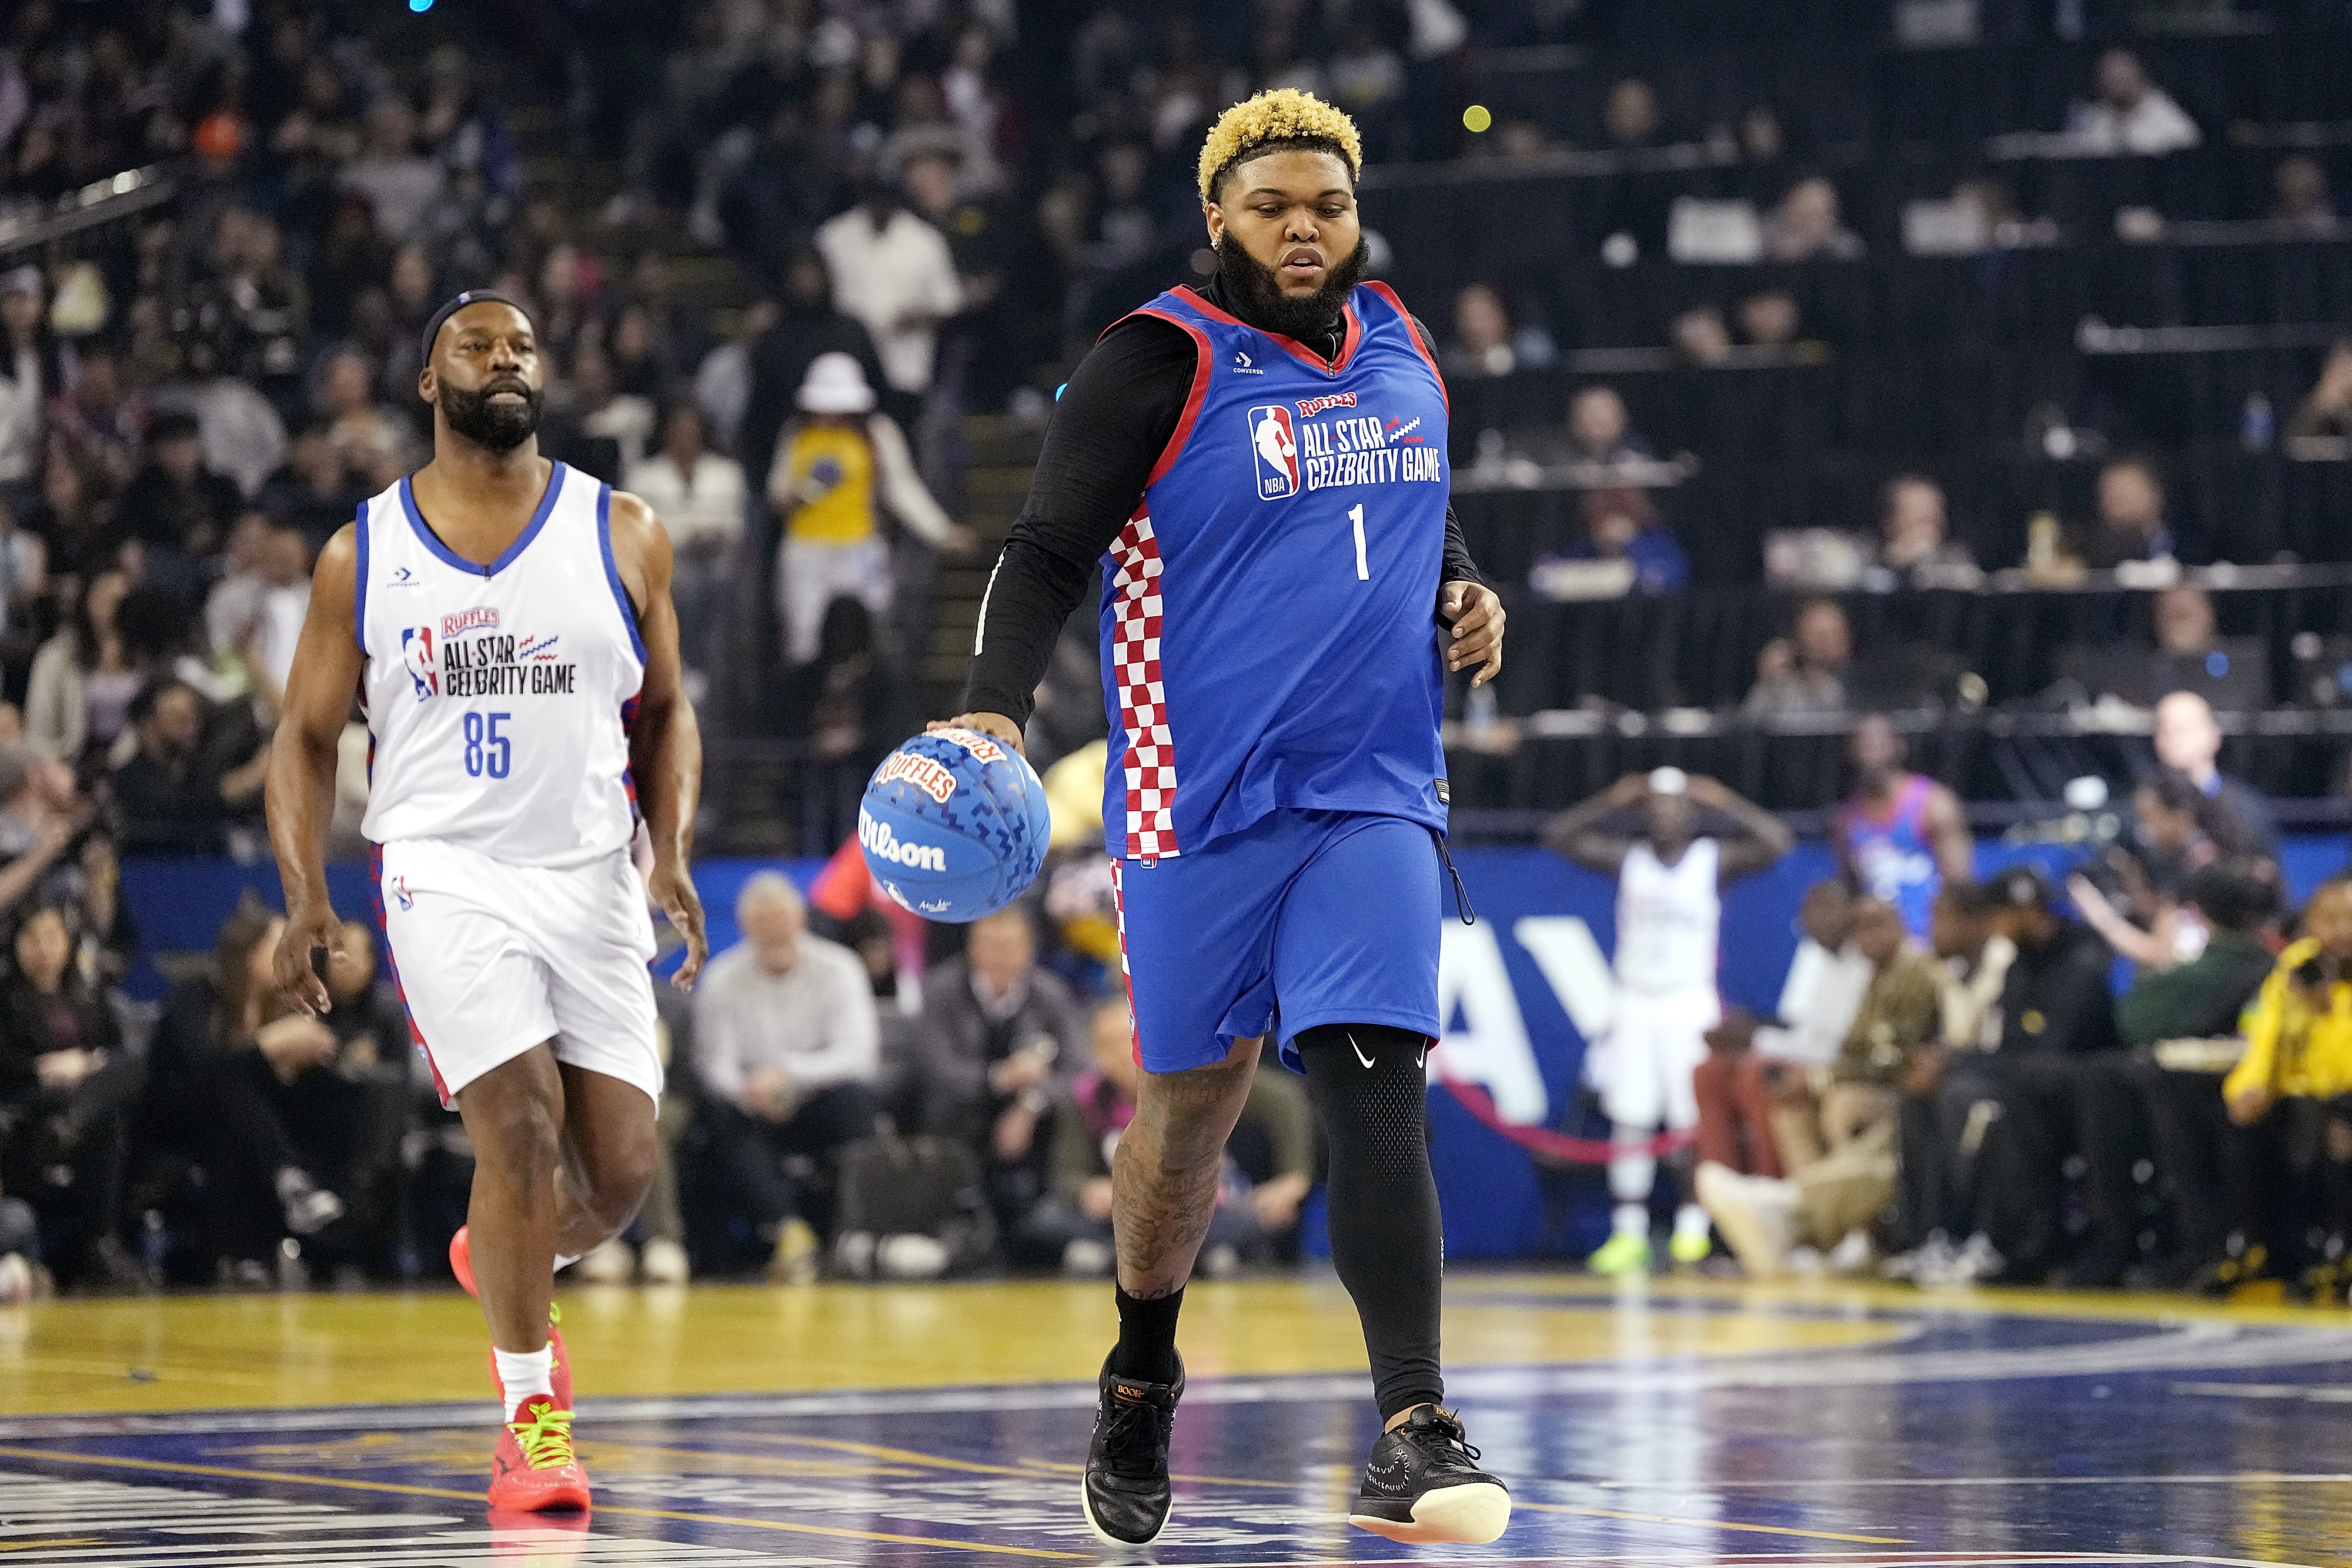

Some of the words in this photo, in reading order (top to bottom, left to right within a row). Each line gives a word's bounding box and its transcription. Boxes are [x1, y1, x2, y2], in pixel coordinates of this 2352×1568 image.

[1296, 392, 1357, 417] RUFFLES
[1302, 422, 1335, 457] ALL
[1335, 417, 1386, 452] STAR
[1265, 476, 1285, 494] NBA
[1306, 448, 1399, 492] CELEBRITY
[1402, 447, 1441, 482] GAME
[1348, 504, 1369, 580] 1
[443, 608, 499, 635] RUFFLES
[445, 641, 473, 671] ALL
[476, 635, 514, 666] STAR
[446, 666, 527, 696] CELEBRITY
[531, 664, 576, 694] GAME
[463, 712, 511, 779] 85
[877, 753, 955, 801] RUFFLES
[1118, 1385, 1142, 1398] BOOK
